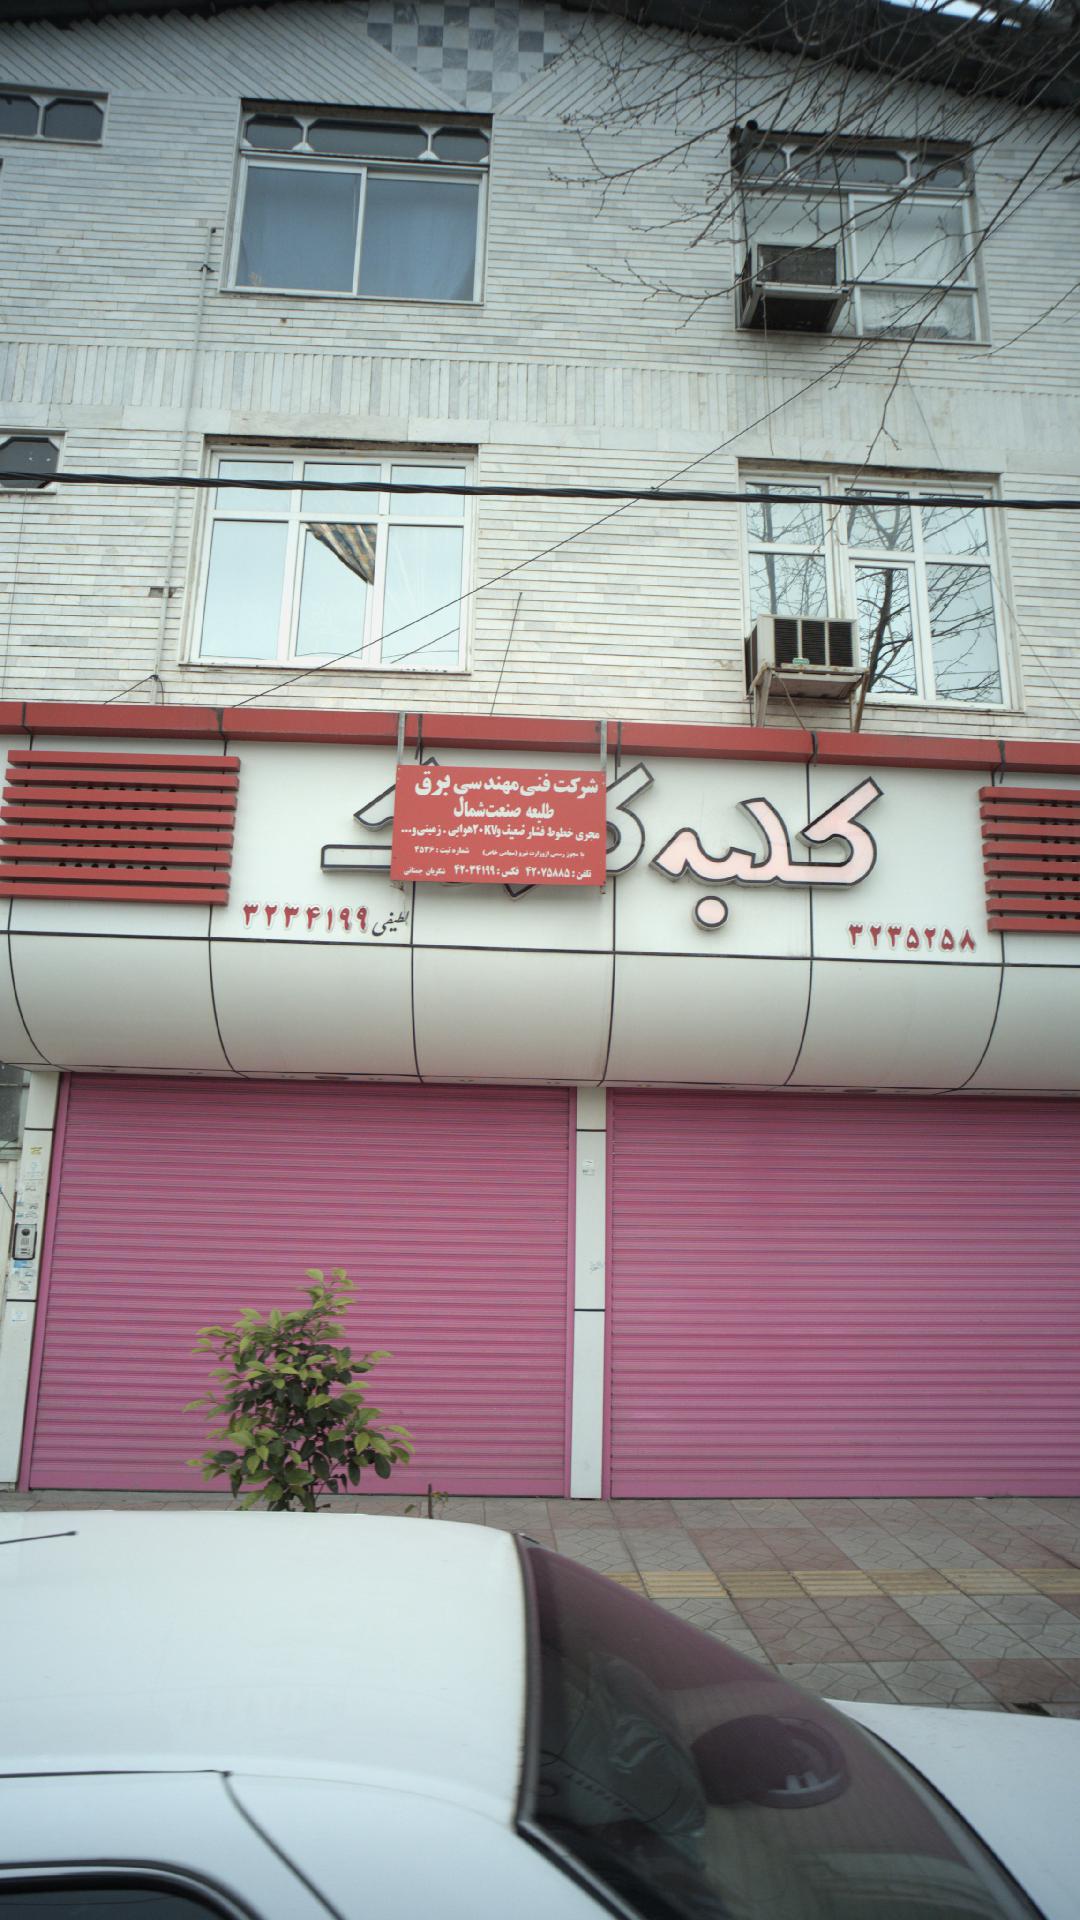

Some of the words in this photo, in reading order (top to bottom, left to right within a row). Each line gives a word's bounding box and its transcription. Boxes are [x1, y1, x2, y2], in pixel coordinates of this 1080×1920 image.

[415, 771, 451, 796] برق
[453, 775, 520, 795] مهندسی
[520, 773, 551, 796] فنی
[553, 777, 599, 799] شرکت
[453, 797, 486, 818] شمال
[486, 803, 522, 818] صنعت
[525, 801, 555, 823] طلیعه
[502, 824, 526, 840] ضعیف
[526, 825, 545, 840] فشار
[547, 826, 573, 841] خطوط
[575, 831, 600, 842] مجری
[650, 776, 883, 931] کلبه
[453, 864, 496, 877] ۴۲۰۳۴۱۹۹
[525, 866, 570, 878] ۴۲۰۷۵۸۸۵
[243, 903, 368, 931] ۳۲۳۴۱۹۹
[849, 923, 976, 951] ۳۲۳۵۲۵۸
